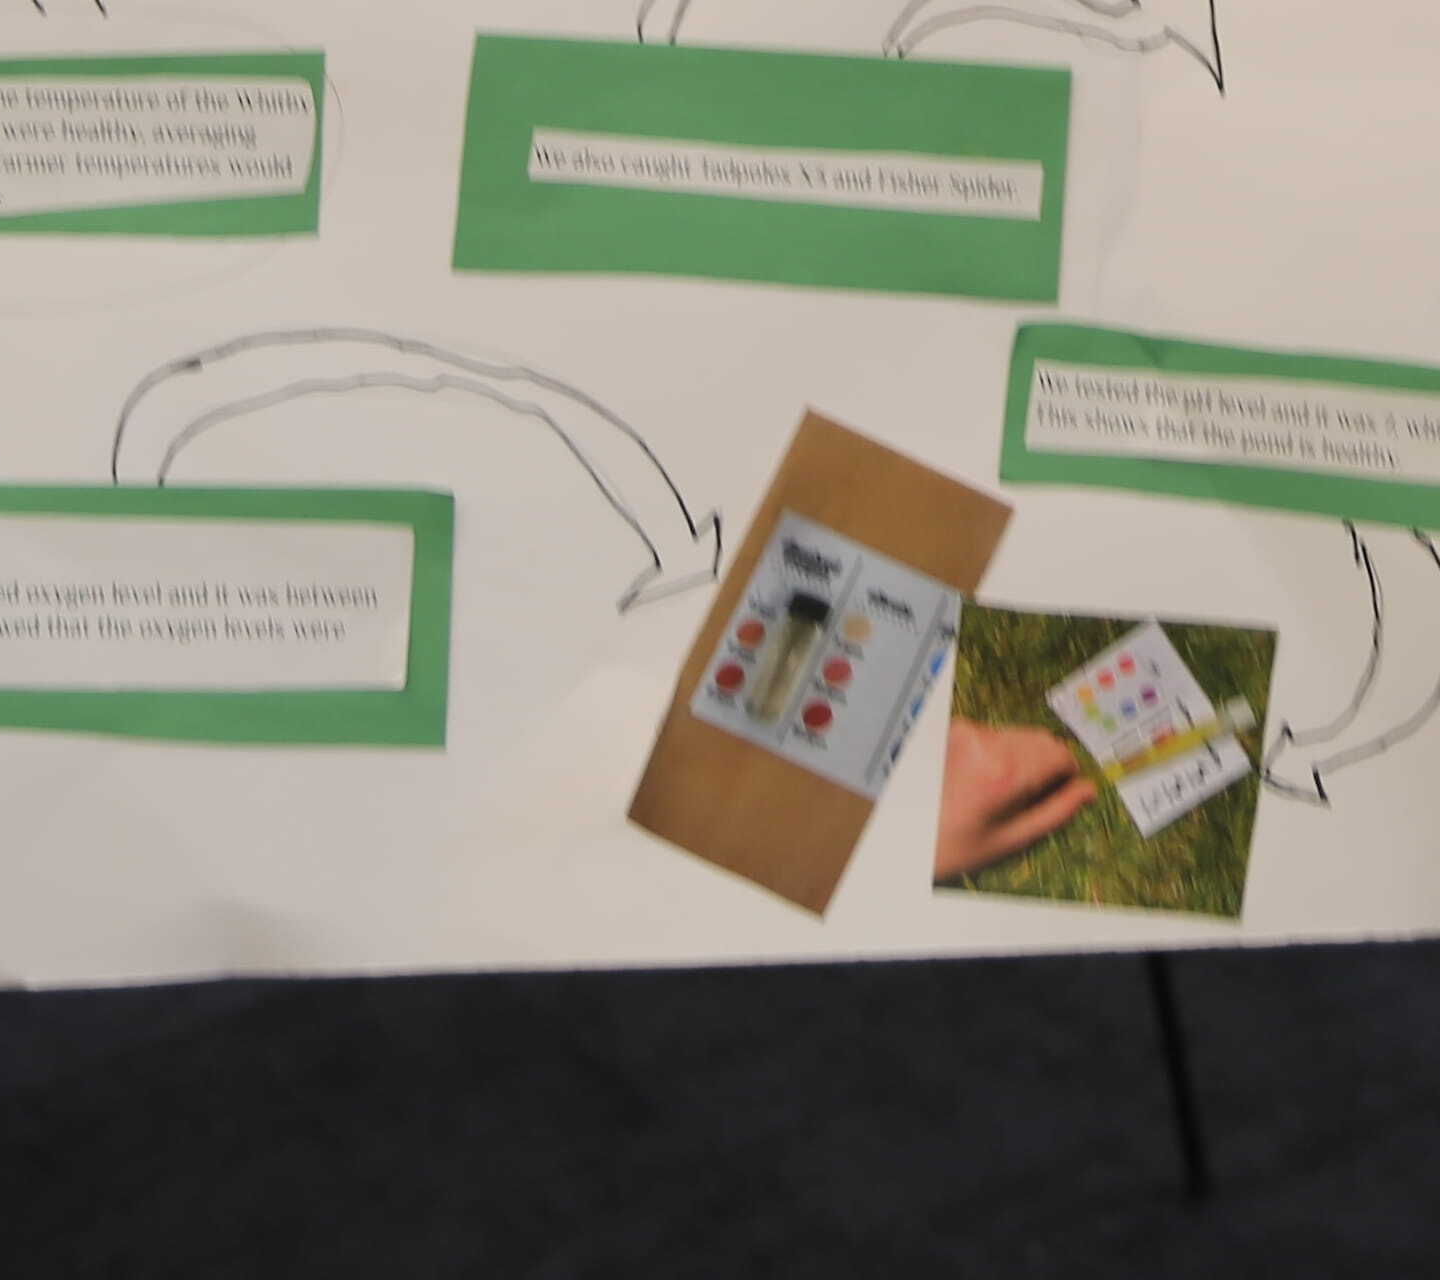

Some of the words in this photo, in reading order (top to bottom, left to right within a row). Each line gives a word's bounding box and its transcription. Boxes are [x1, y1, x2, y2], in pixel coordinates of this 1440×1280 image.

[24, 85, 158, 114] temperature
[165, 88, 187, 112] of
[194, 87, 229, 113] the
[235, 87, 310, 116] Whitby
[2, 121, 56, 143] were
[152, 122, 257, 151] averaging
[75, 151, 222, 182] temperatures
[227, 153, 293, 179] would
[535, 142, 569, 171] We
[572, 145, 615, 174] also
[620, 151, 691, 183] caught
[702, 153, 792, 188] Tadpoles
[832, 161, 872, 190] and
[1037, 367, 1069, 395] We
[1074, 372, 1139, 405] tested
[1144, 377, 1178, 407] the
[1182, 386, 1213, 415] pH
[1218, 388, 1267, 421] level
[1271, 399, 1310, 427] and
[1315, 402, 1329, 429] it
[1335, 408, 1377, 434] was
[1037, 400, 1078, 430] This
[1084, 407, 1150, 436] shows
[1155, 414, 1196, 443] that
[1202, 420, 1237, 448] the
[1241, 427, 1294, 456] pond
[1298, 433, 1316, 460] is
[26, 583, 105, 612] oxygen
[112, 577, 162, 606] level
[168, 579, 208, 607] and
[216, 580, 228, 607] it
[238, 585, 280, 608] was
[285, 580, 378, 612] between
[47, 612, 89, 640] that
[98, 613, 133, 640] the
[139, 617, 217, 645] oxygen
[224, 613, 286, 640] levels
[293, 617, 347, 640] were
